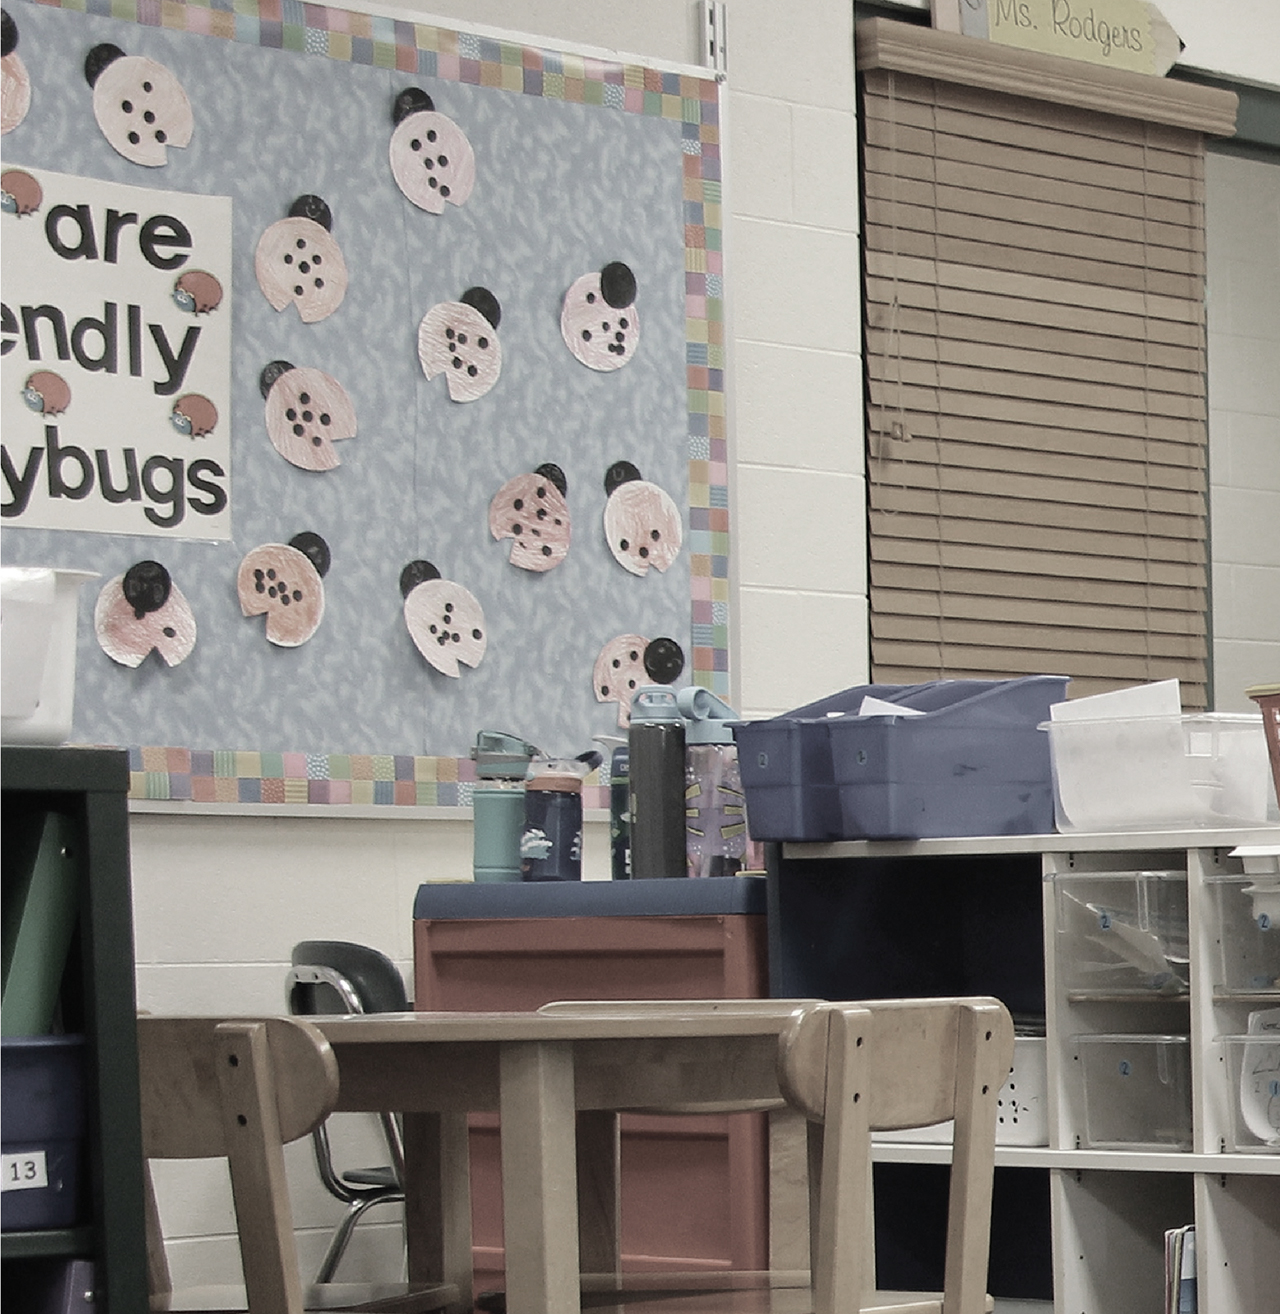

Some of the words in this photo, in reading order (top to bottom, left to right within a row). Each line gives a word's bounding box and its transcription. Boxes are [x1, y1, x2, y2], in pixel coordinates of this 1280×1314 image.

[995, 0, 1038, 30] Ms.
[1052, 0, 1143, 56] Rodgers
[45, 203, 194, 271] are
[1, 424, 228, 529] ybugs
[1102, 914, 1110, 929] 2
[1260, 915, 1269, 929] 2
[1121, 1062, 1129, 1076] 2
[10, 1161, 37, 1181] 13
